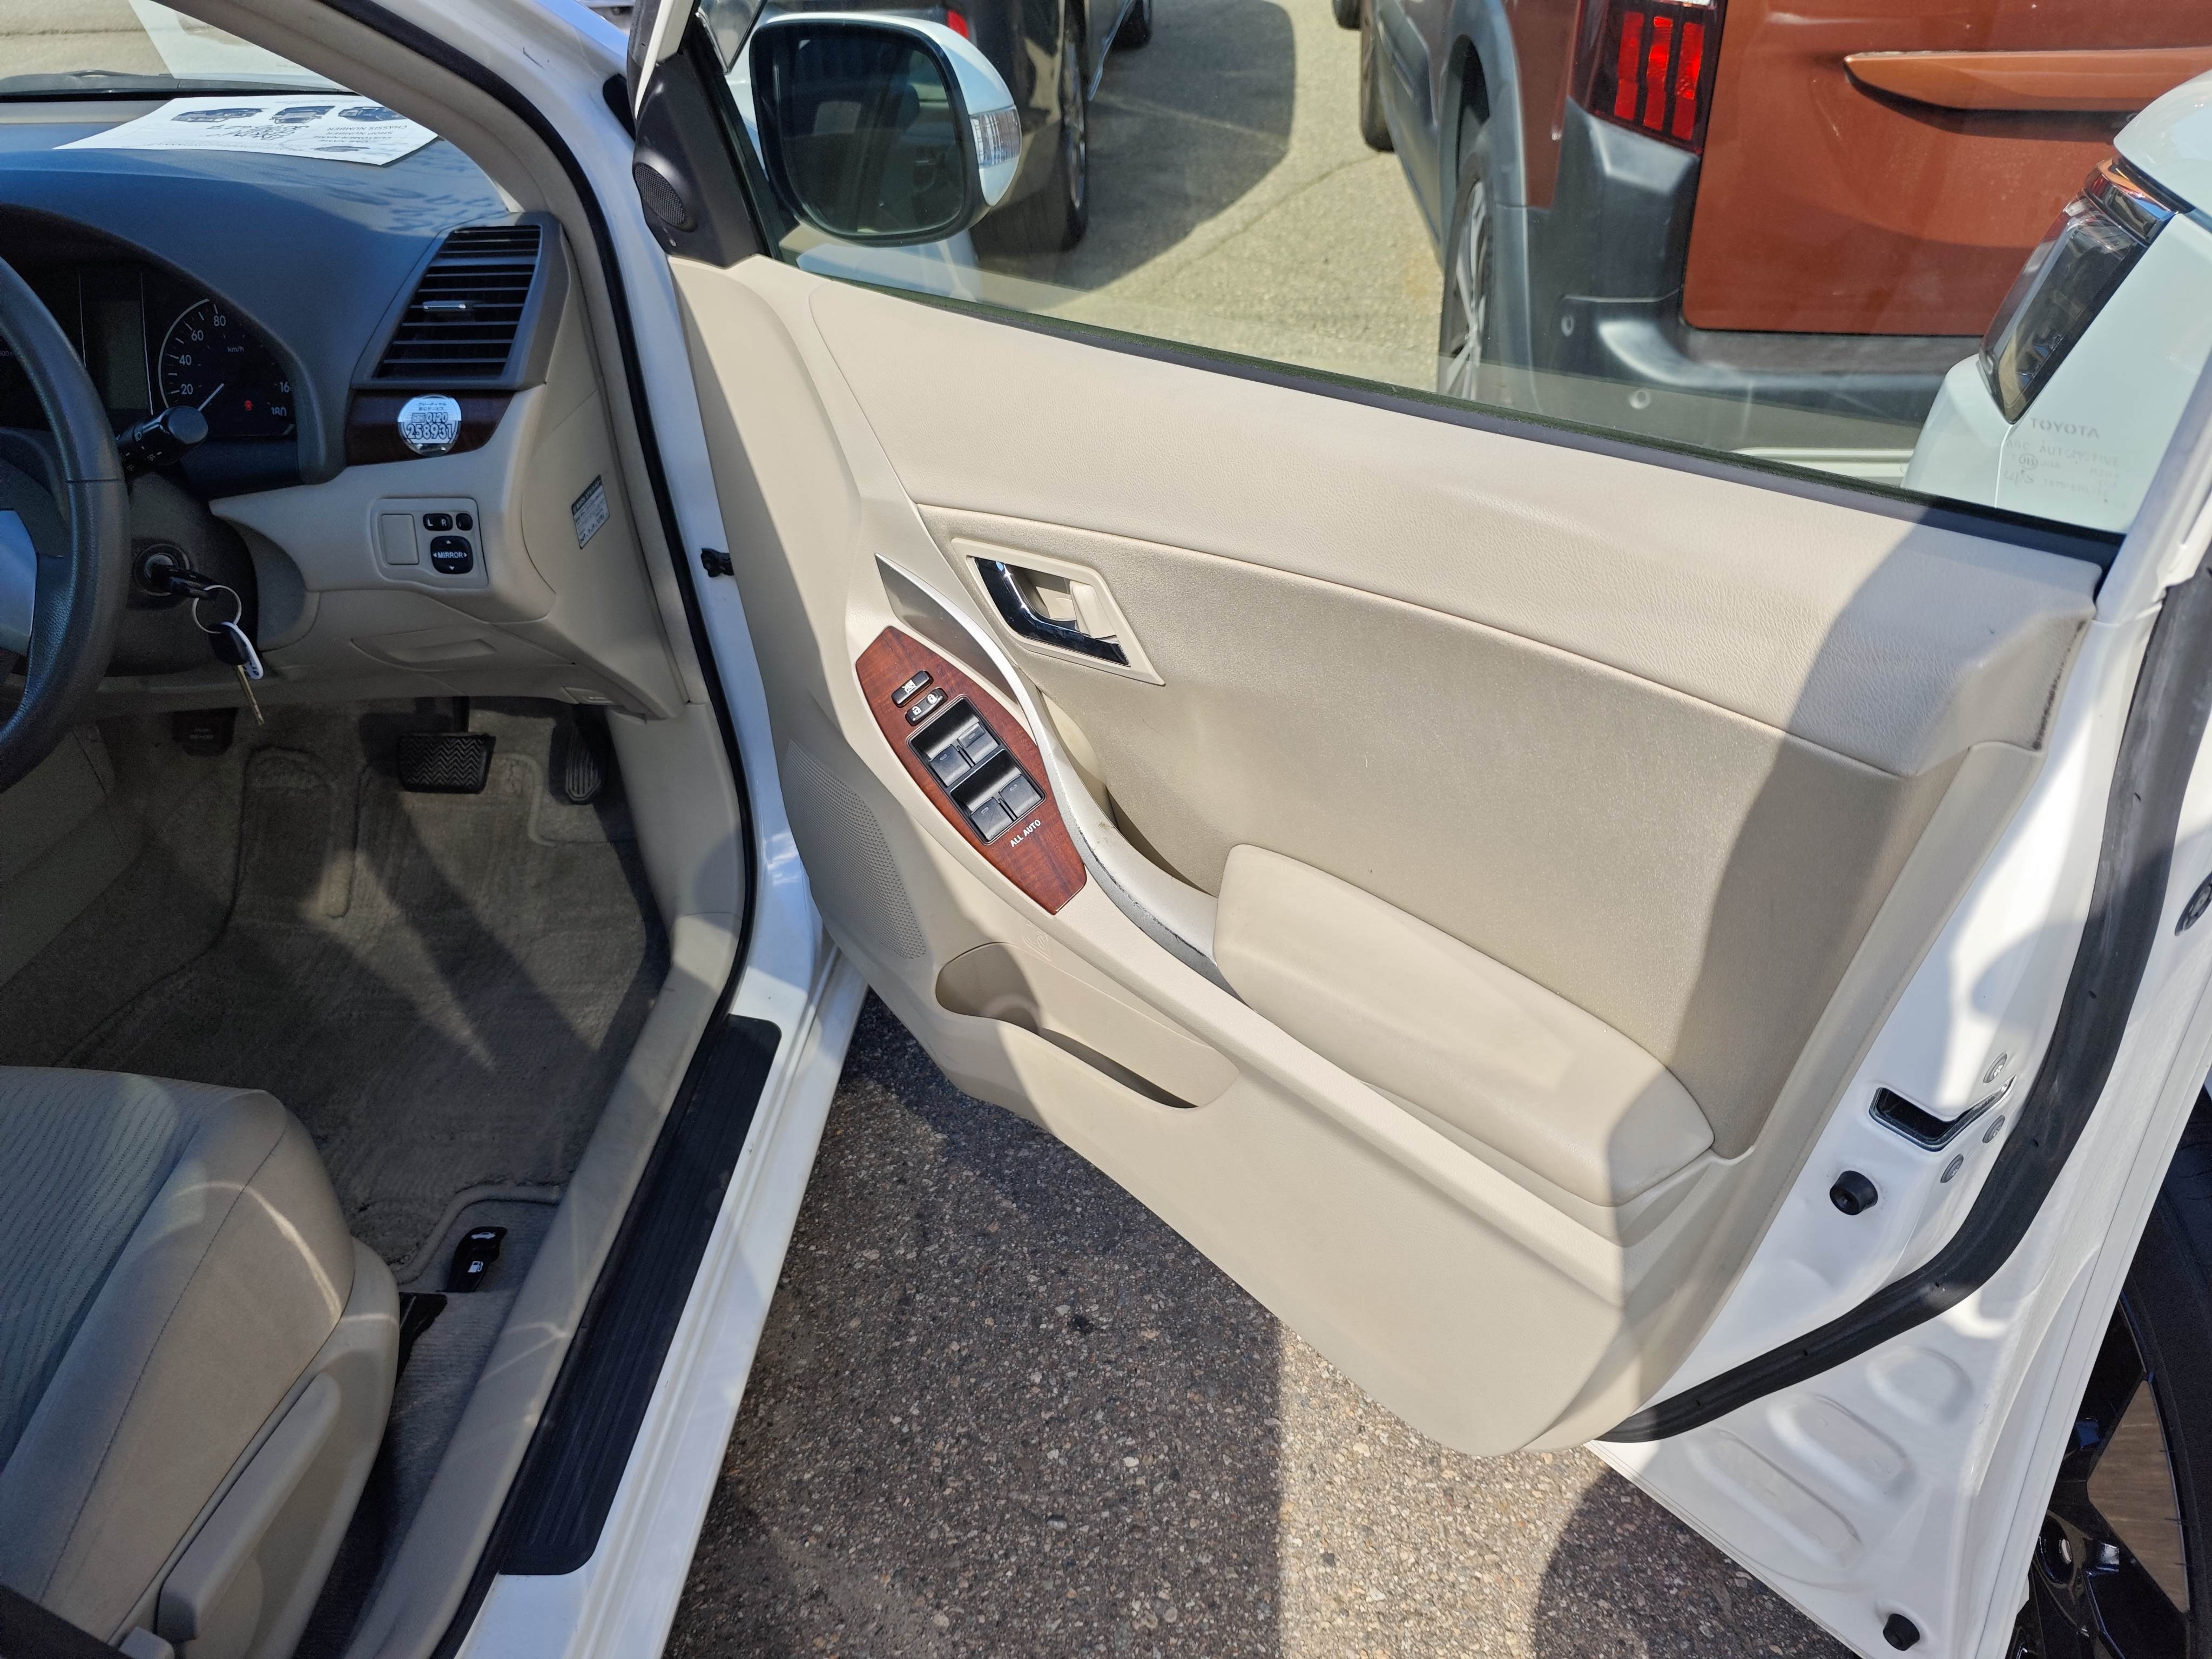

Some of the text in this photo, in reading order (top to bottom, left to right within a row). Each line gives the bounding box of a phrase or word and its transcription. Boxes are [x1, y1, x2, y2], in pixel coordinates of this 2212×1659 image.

[213, 315, 226, 327] 80
[191, 329, 204, 341] 60
[179, 354, 192, 366] 40
[181, 383, 193, 395] 20
[280, 381, 291, 393] 16
[426, 412, 449, 423] 0120
[406, 423, 453, 440] 258931
[2030, 418, 2099, 439] TOYOTA
[427, 518, 447, 527] L R
[1010, 819, 1041, 847] ALL AUTO
